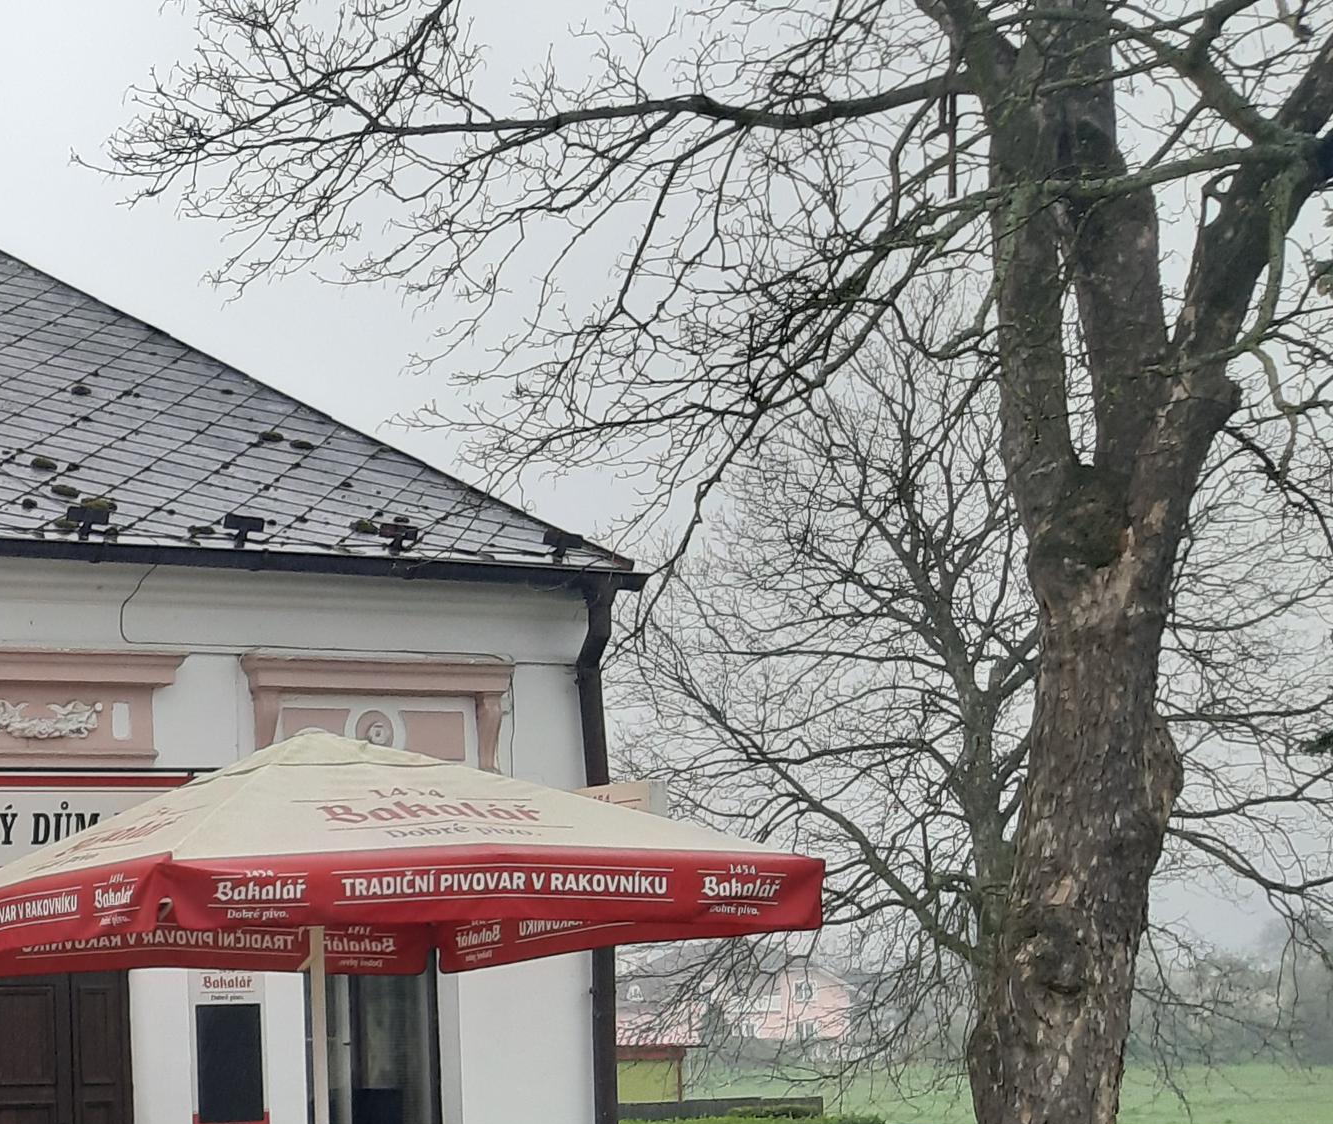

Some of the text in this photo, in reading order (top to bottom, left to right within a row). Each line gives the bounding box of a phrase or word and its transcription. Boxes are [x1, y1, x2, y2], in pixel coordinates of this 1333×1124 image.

[30, 800, 101, 846] DŮM
[316, 800, 541, 824] Bakalář
[385, 823, 470, 838] Dobré
[729, 863, 756, 875] 1454
[213, 877, 307, 902] Bakalář
[341, 870, 668, 897] TRADIČNÍ PIVOVAR V RAKOVNÍKU
[701, 876, 781, 897] Bakalář
[17, 902, 25, 920] V
[25, 892, 78, 918] RAKOVNÍKU
[226, 908, 290, 922] Dobré pivo.
[202, 975, 253, 989] Bakalář
